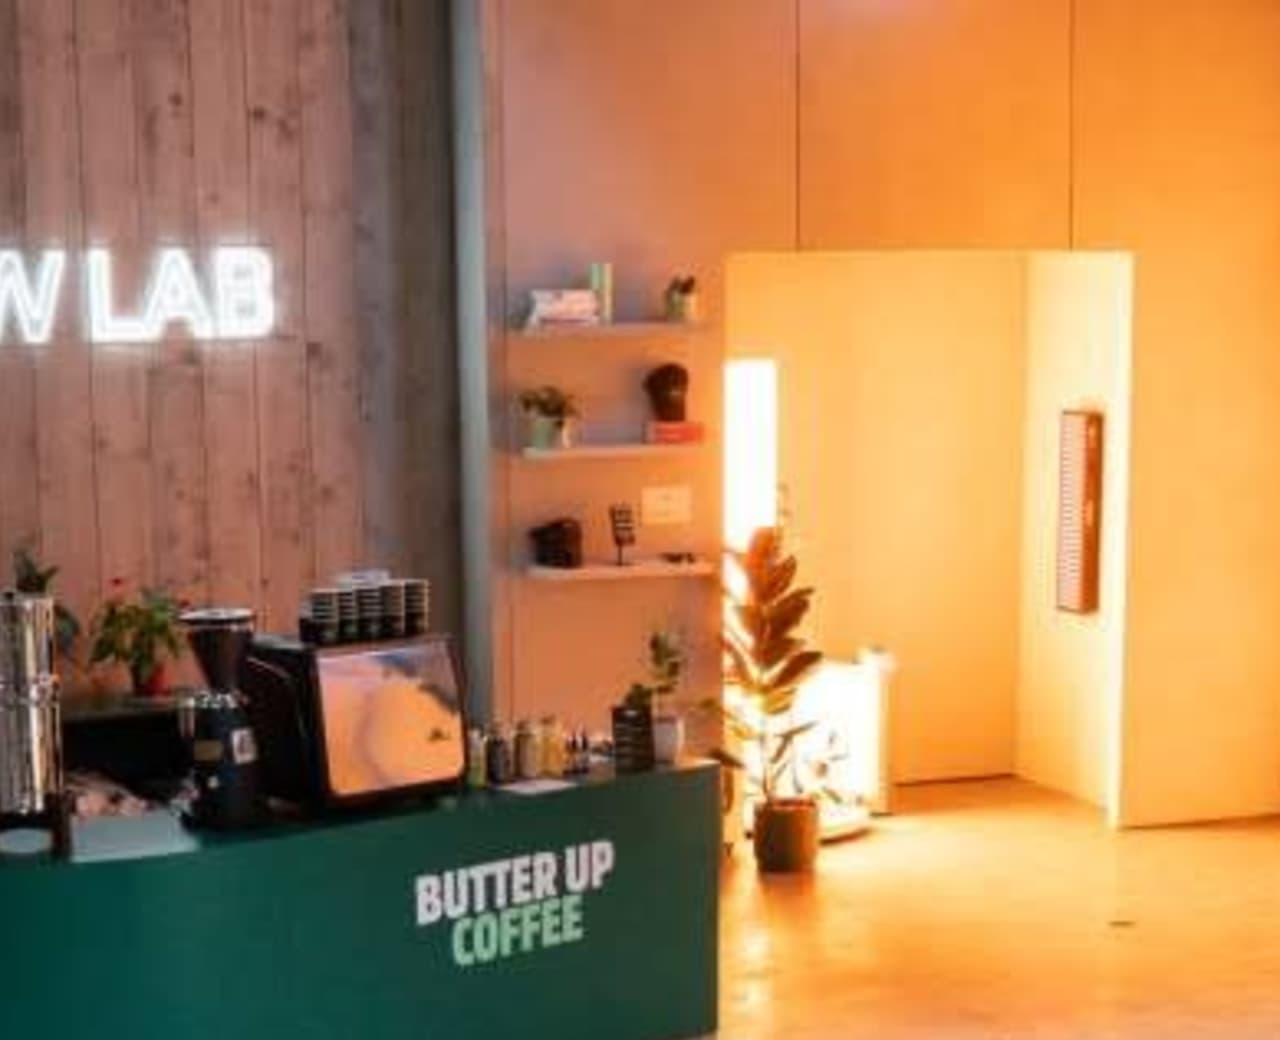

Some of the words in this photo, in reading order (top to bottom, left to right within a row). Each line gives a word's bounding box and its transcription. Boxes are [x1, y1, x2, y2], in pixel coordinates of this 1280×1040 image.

[86, 245, 276, 343] LAB
[416, 852, 557, 926] BUTTER
[565, 841, 614, 892] UP
[452, 895, 584, 966] COFFEE
